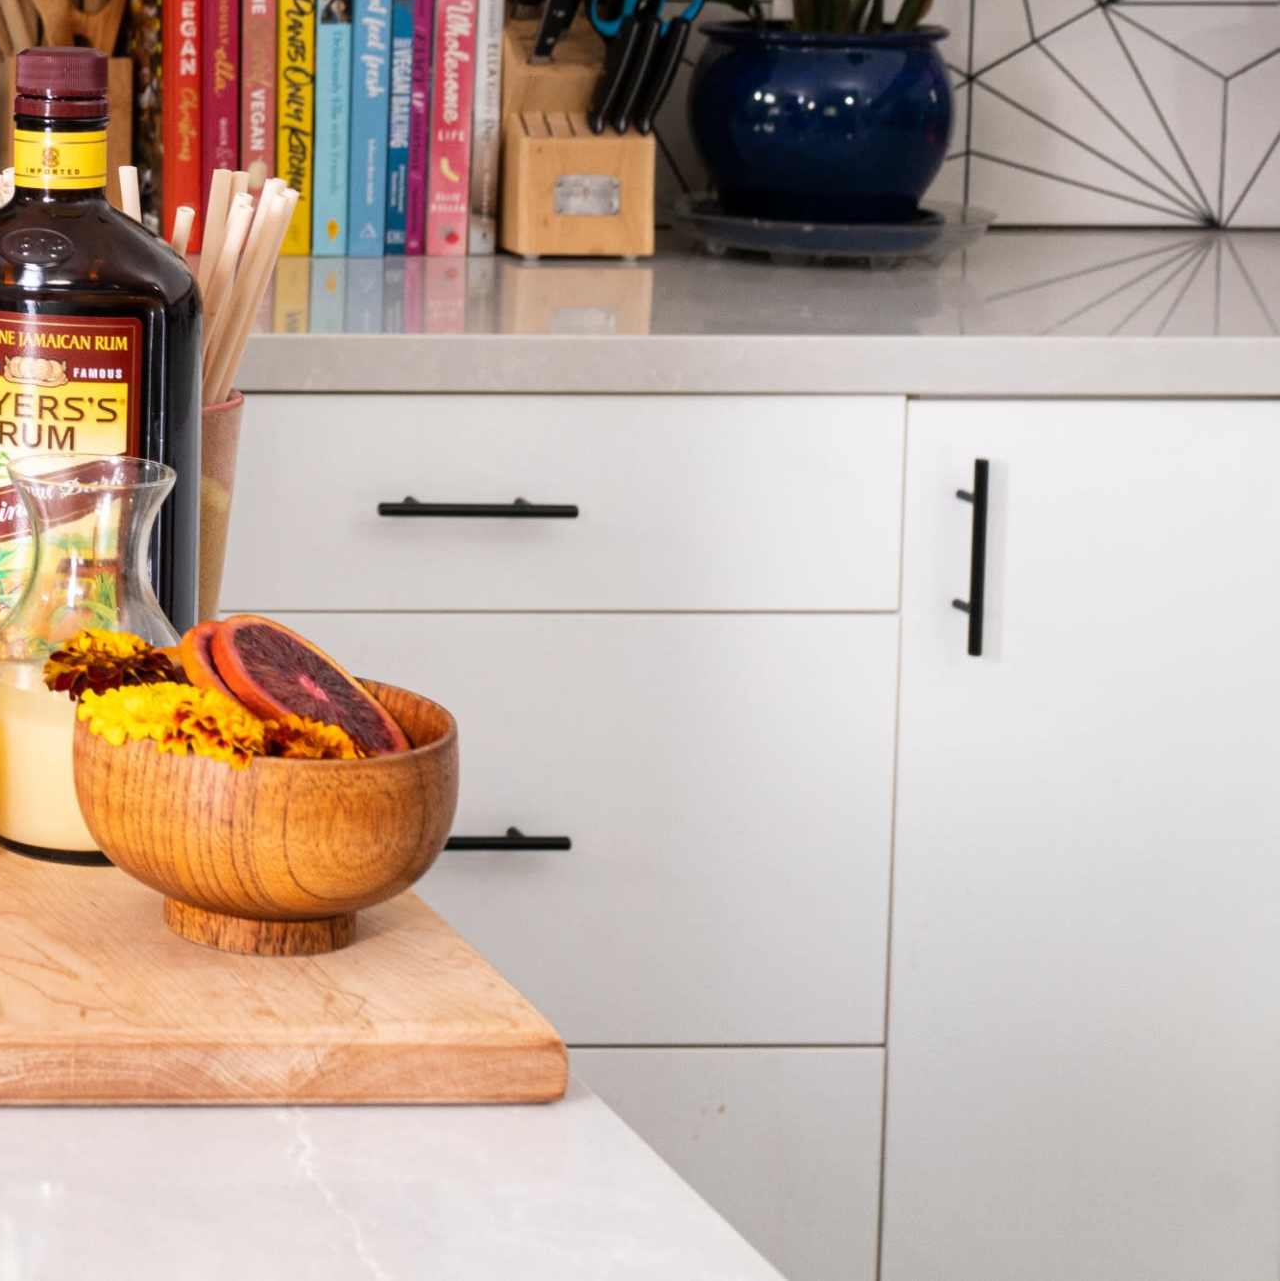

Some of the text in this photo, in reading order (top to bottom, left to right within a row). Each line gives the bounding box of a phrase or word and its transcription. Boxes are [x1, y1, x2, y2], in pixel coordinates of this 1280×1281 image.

[392, 48, 411, 94] VEGAN
[442, 0, 474, 124] Wholesome
[283, 64, 314, 123] ONLY
[249, 88, 266, 151] VEGAN
[25, 167, 81, 176] IMPORTED
[18, 332, 91, 352] JAMAICAN
[95, 336, 128, 351] RUM
[72, 367, 123, 380] FAMOUS
